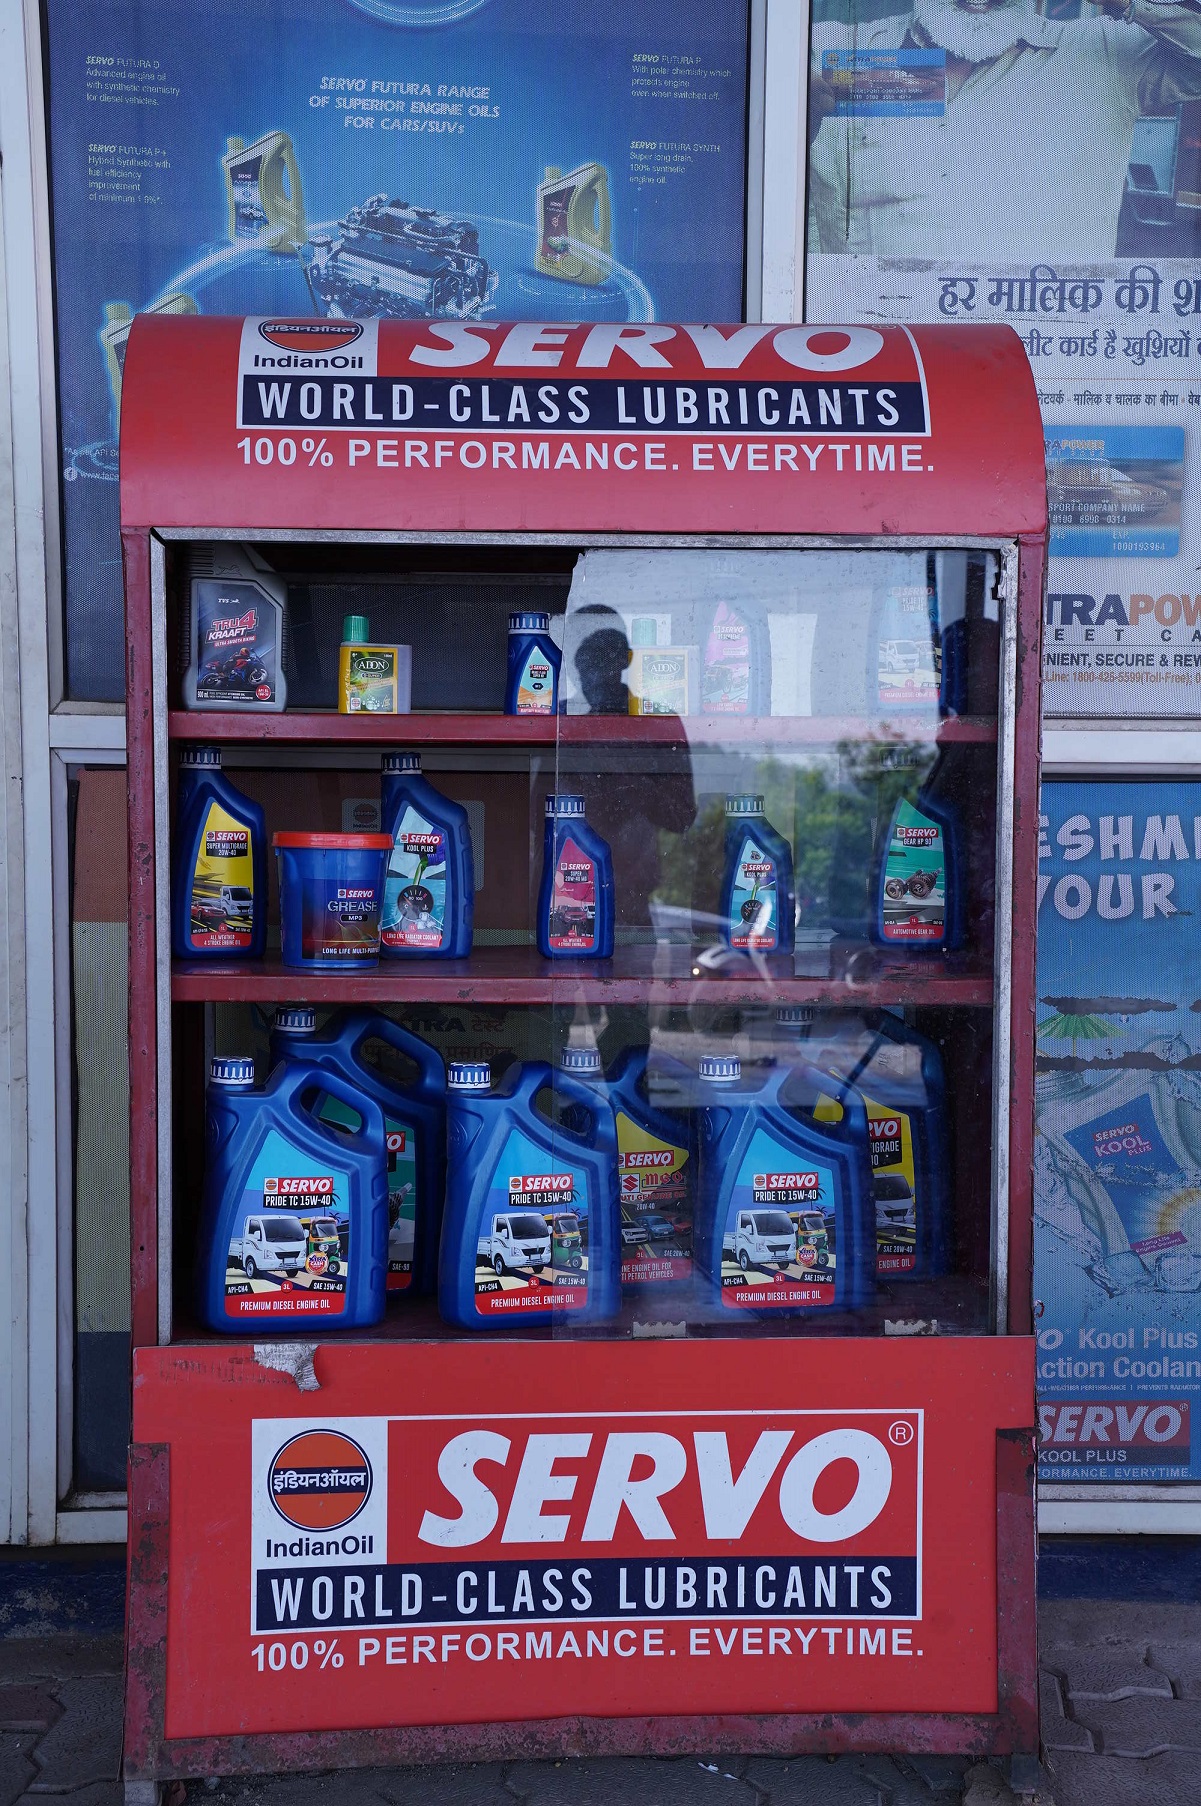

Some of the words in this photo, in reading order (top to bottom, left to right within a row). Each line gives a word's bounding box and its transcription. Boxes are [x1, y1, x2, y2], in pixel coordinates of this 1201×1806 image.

[87, 68, 125, 78] Advanced
[105, 82, 139, 91] synthetic
[143, 85, 180, 96] chemistry
[320, 76, 367, 91] SERVO
[372, 81, 431, 96] FUTURA
[438, 86, 490, 99] RANGE
[100, 94, 122, 102] diesel
[309, 95, 330, 107] OF
[335, 97, 405, 113] SUPERIOR
[410, 102, 463, 116] ENGINE
[468, 105, 500, 118] OILS
[344, 116, 374, 128] FOR
[381, 118, 465, 134] CARS/SUVs
[938, 278, 978, 315] हर
[988, 264, 1104, 314] मालिक
[1115, 264, 1163, 314] की
[408, 322, 884, 372] SERVO
[1059, 329, 1099, 356] कार्ड
[1104, 329, 1116, 359] है
[1123, 329, 1190, 365] खुशियों
[254, 355, 363, 369] IndianOil
[258, 383, 590, 425] WORLD-CLASS
[617, 387, 900, 426] LUBRICANTS
[1074, 390, 1102, 406] मालिक
[1115, 393, 1141, 406] चालक
[1145, 394, 1155, 406] का
[237, 437, 334, 467] 100%
[349, 439, 678, 472] PERFORMANCE.
[693, 443, 934, 472] EVERYTIME.
[1078, 503, 1118, 512] COMPANY
[1122, 503, 1145, 512] NAME
[209, 627, 247, 641] KRAAFT
[1096, 653, 1154, 666] SECURE
[1160, 654, 1168, 666] &
[410, 835, 440, 843] SERVO
[906, 829, 937, 837] SERVO
[347, 890, 372, 898] SERVO
[328, 901, 377, 912] GREASE
[1095, 1124, 1136, 1141] SERVO
[1095, 1135, 1150, 1158] KOOL
[628, 1152, 672, 1167] SERVO
[281, 1179, 330, 1193] SERVO
[525, 1176, 571, 1190] SERVO
[769, 1174, 816, 1187] SERVO
[265, 1196, 287, 1206] PRIDE
[289, 1195, 298, 1205] TC
[300, 1195, 331, 1205] 15W-40
[511, 1194, 531, 1204] PRIDE
[533, 1193, 542, 1203] TC
[544, 1192, 572, 1203] 15W-40
[755, 1192, 776, 1201] PRIDE
[778, 1191, 786, 1200] TC
[788, 1190, 817, 1201] 15W-40
[879, 1259, 900, 1269] ENGINE
[901, 1258, 911, 1267] OIL
[628, 1272, 647, 1280] PETROL
[491, 1297, 520, 1308] PREMIUM
[522, 1297, 542, 1306] DIESEL
[543, 1295, 564, 1304] ENGINE
[566, 1295, 574, 1303] OIL
[736, 1293, 765, 1302] PREMIUM
[767, 1292, 787, 1301] DIESEL
[789, 1291, 810, 1300] ENGINE
[812, 1291, 821, 1299] OIL
[240, 1301, 270, 1311] PREMIUM
[273, 1301, 295, 1310] DIESEL
[296, 1300, 318, 1309] ENGINE
[320, 1299, 330, 1308] OIL
[1079, 1328, 1134, 1349] Kool
[1144, 1328, 1198, 1349] Plus
[1039, 1405, 1182, 1442] SERVO
[1086, 1450, 1127, 1462] PLUS
[1115, 1467, 1192, 1477] EVERYTIME.
[274, 1469, 366, 1493] इंडियनऑयल
[417, 1428, 893, 1548] SERVO
[266, 1536, 373, 1558] IndianOil
[271, 1568, 592, 1622] WORLD-CLASS
[619, 1565, 892, 1610] LUBRICANTS
[251, 1639, 344, 1672] 100%
[358, 1628, 676, 1667] PERFORMANCE.
[689, 1627, 923, 1656] EVERYTIME.
